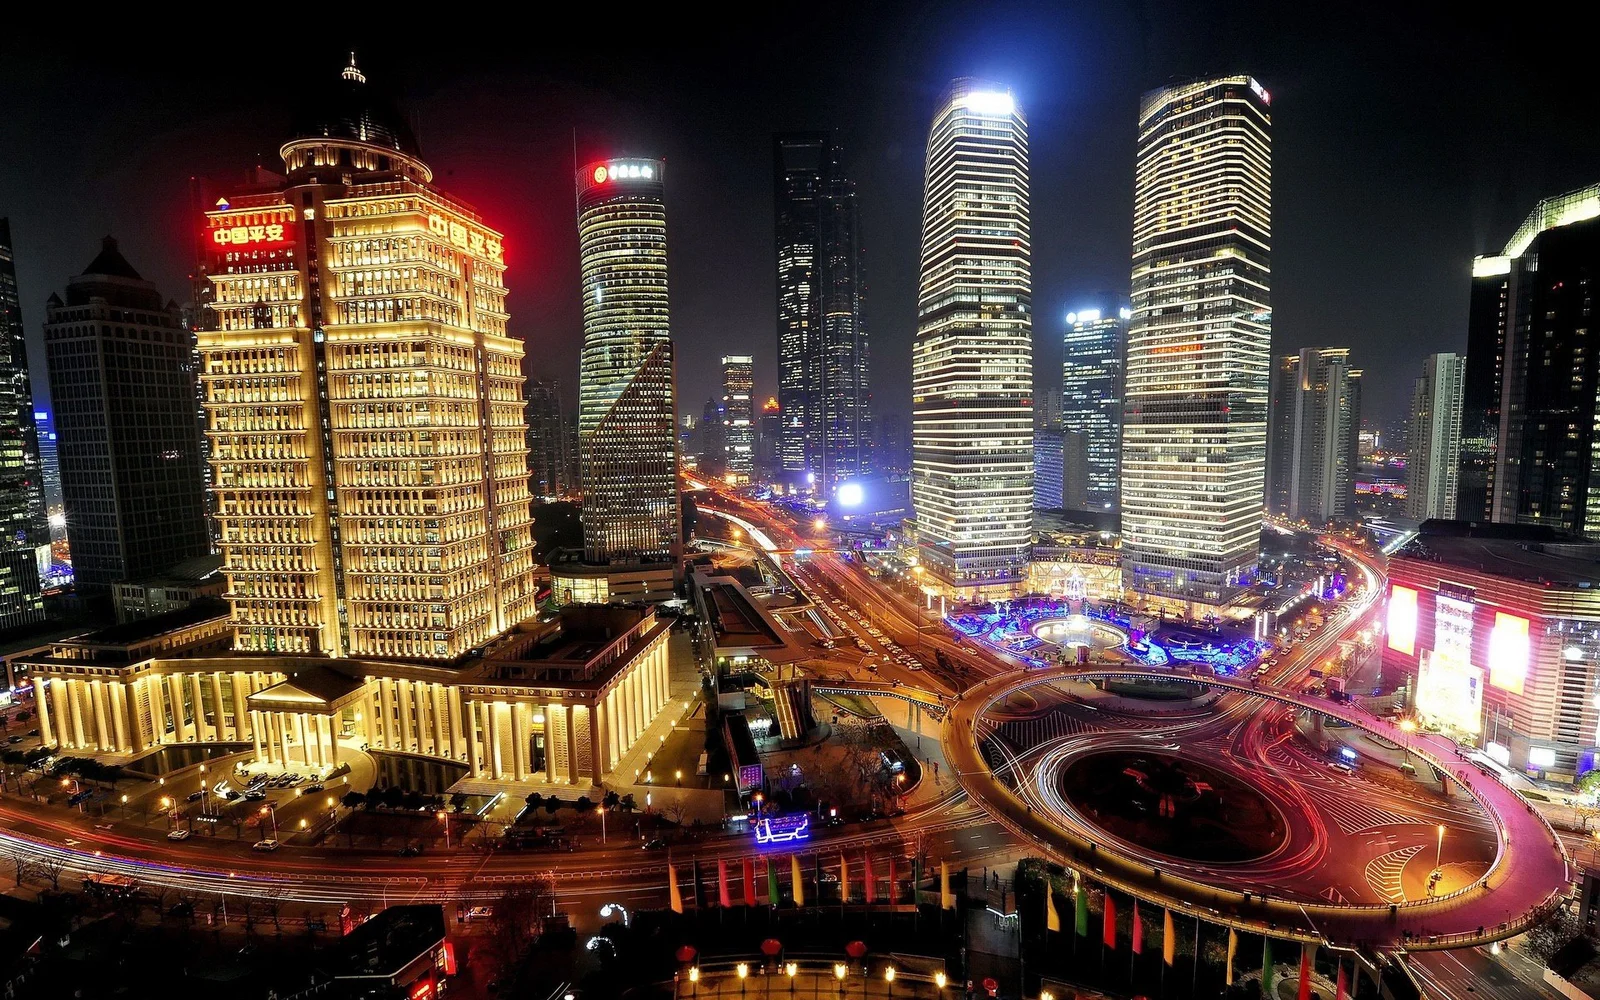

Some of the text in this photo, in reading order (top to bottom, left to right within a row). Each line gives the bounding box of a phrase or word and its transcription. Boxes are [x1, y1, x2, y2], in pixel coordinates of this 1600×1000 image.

[214, 224, 284, 245] 中国平安
[429, 214, 503, 263] 中国平安
